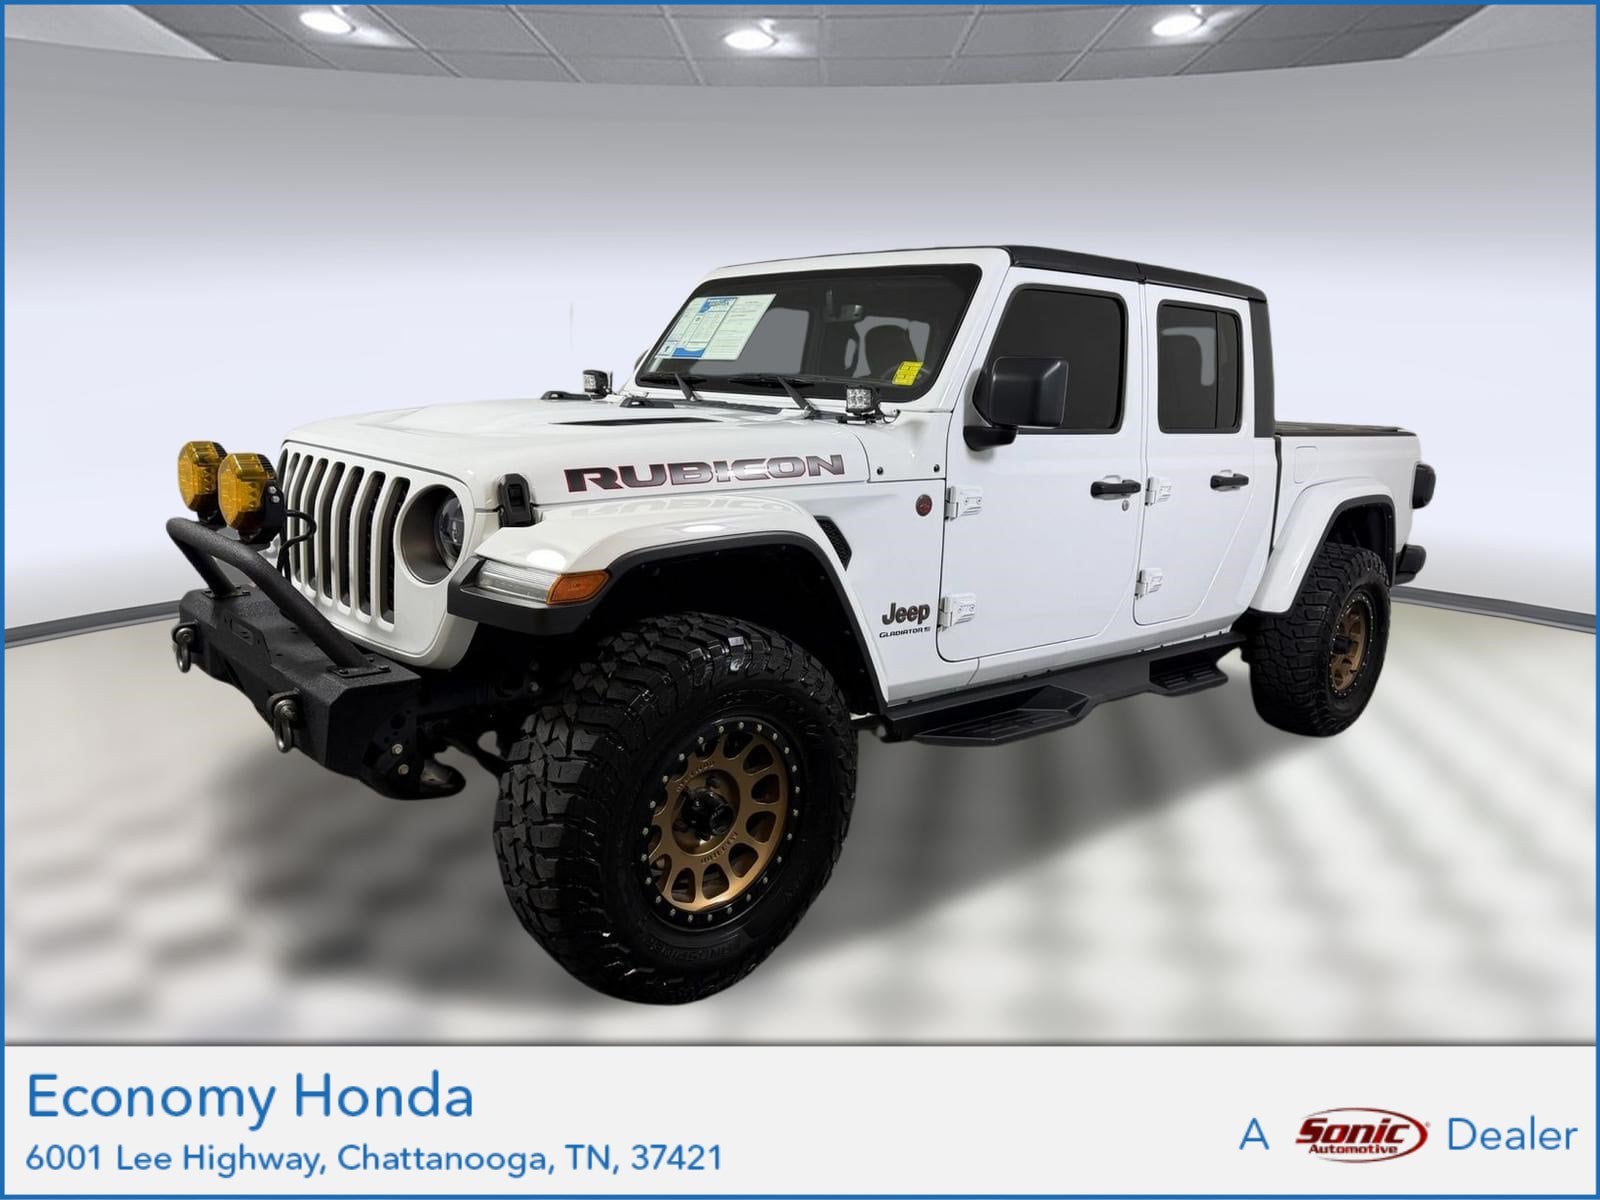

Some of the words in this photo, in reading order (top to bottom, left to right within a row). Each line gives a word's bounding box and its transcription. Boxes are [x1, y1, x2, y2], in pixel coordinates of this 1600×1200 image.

[564, 454, 845, 492] RUBICON
[882, 602, 931, 625] Jeep
[879, 627, 924, 638] GLADIATOR
